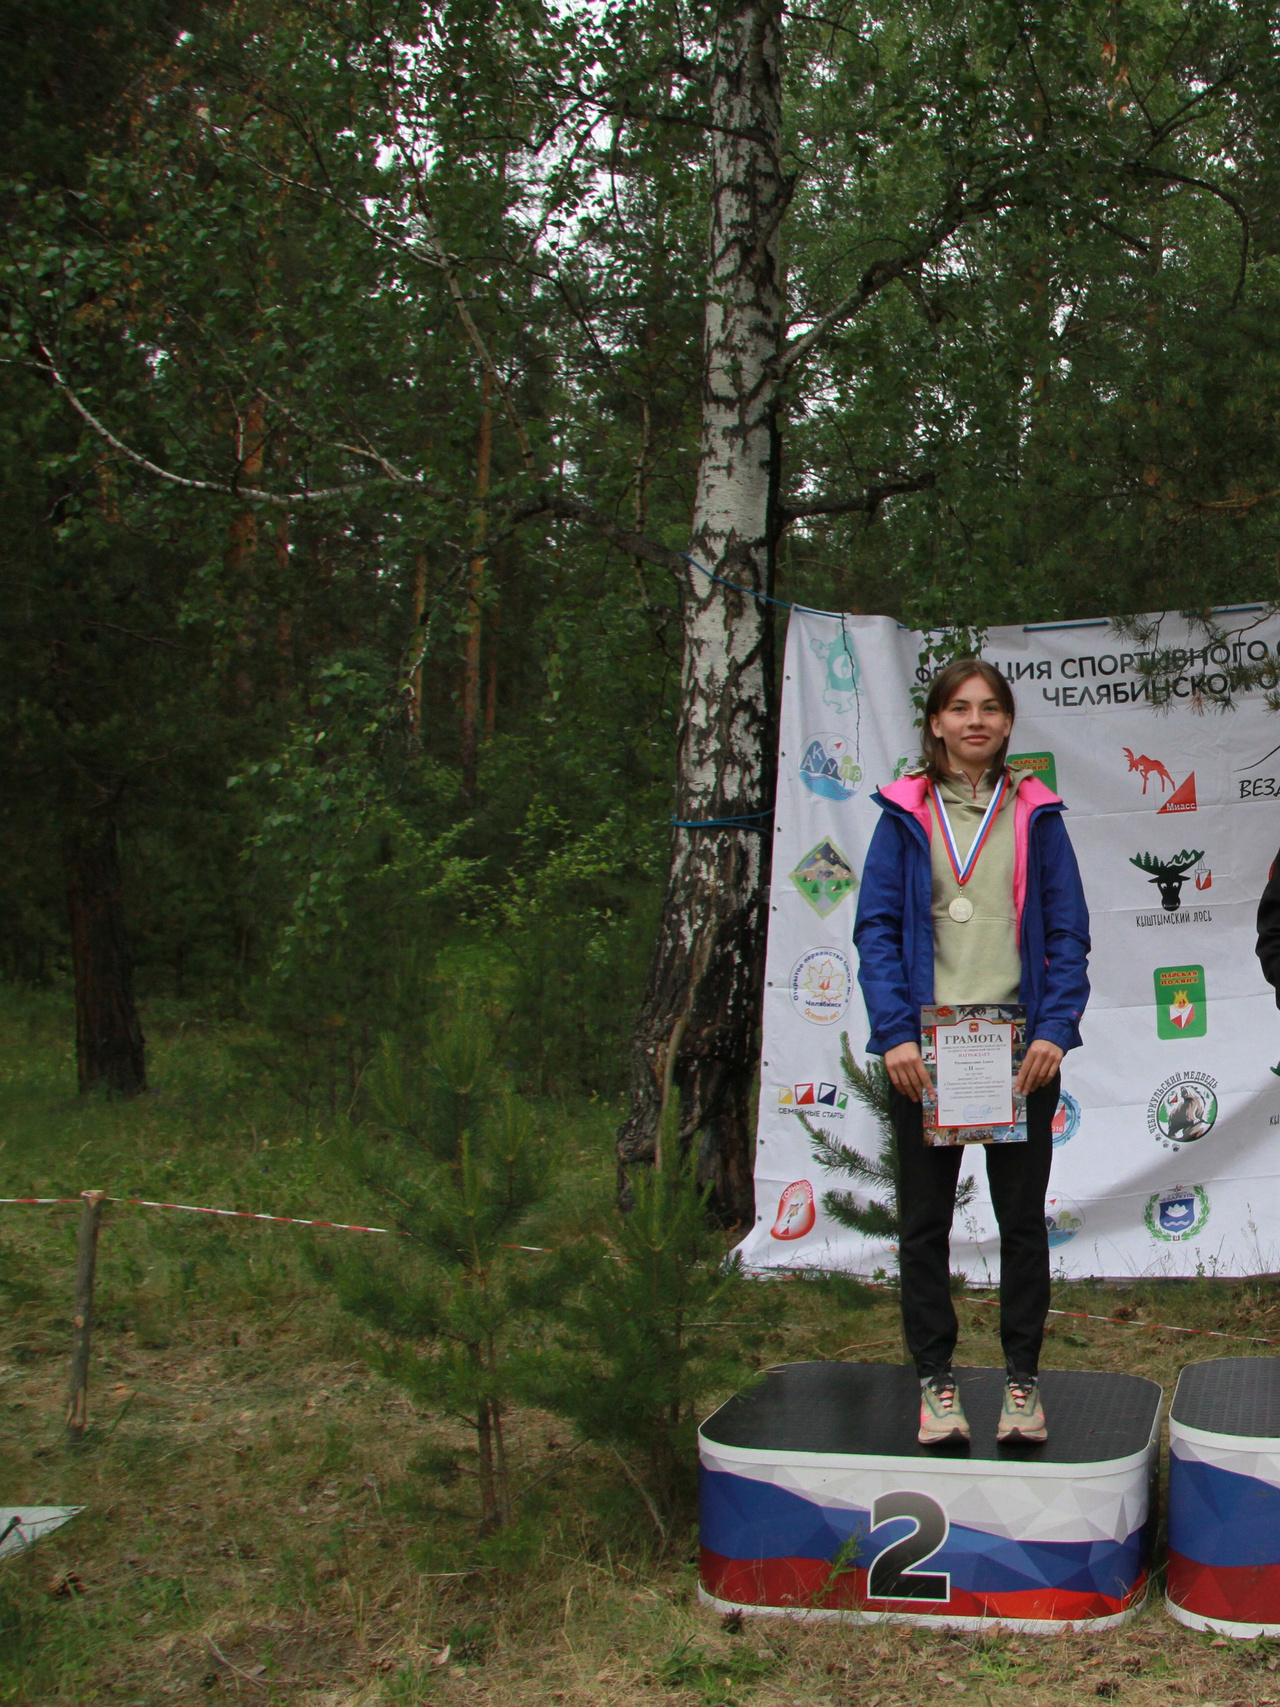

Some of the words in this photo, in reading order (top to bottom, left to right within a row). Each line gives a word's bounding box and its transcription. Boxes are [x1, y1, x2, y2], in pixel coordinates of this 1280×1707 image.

[1166, 801, 1196, 812] Миасс
[1135, 910, 1191, 928] КЫШТЫМСКИЙ
[1160, 978, 1199, 986] ПОЛЯНА
[945, 1033, 1004, 1045] ГРАМОТА
[1146, 1071, 1182, 1134] ЧЕБАРКУЛЬСКИЙ
[1183, 1070, 1219, 1089] МЕДВЕДЬ
[867, 1490, 950, 1602] 2
